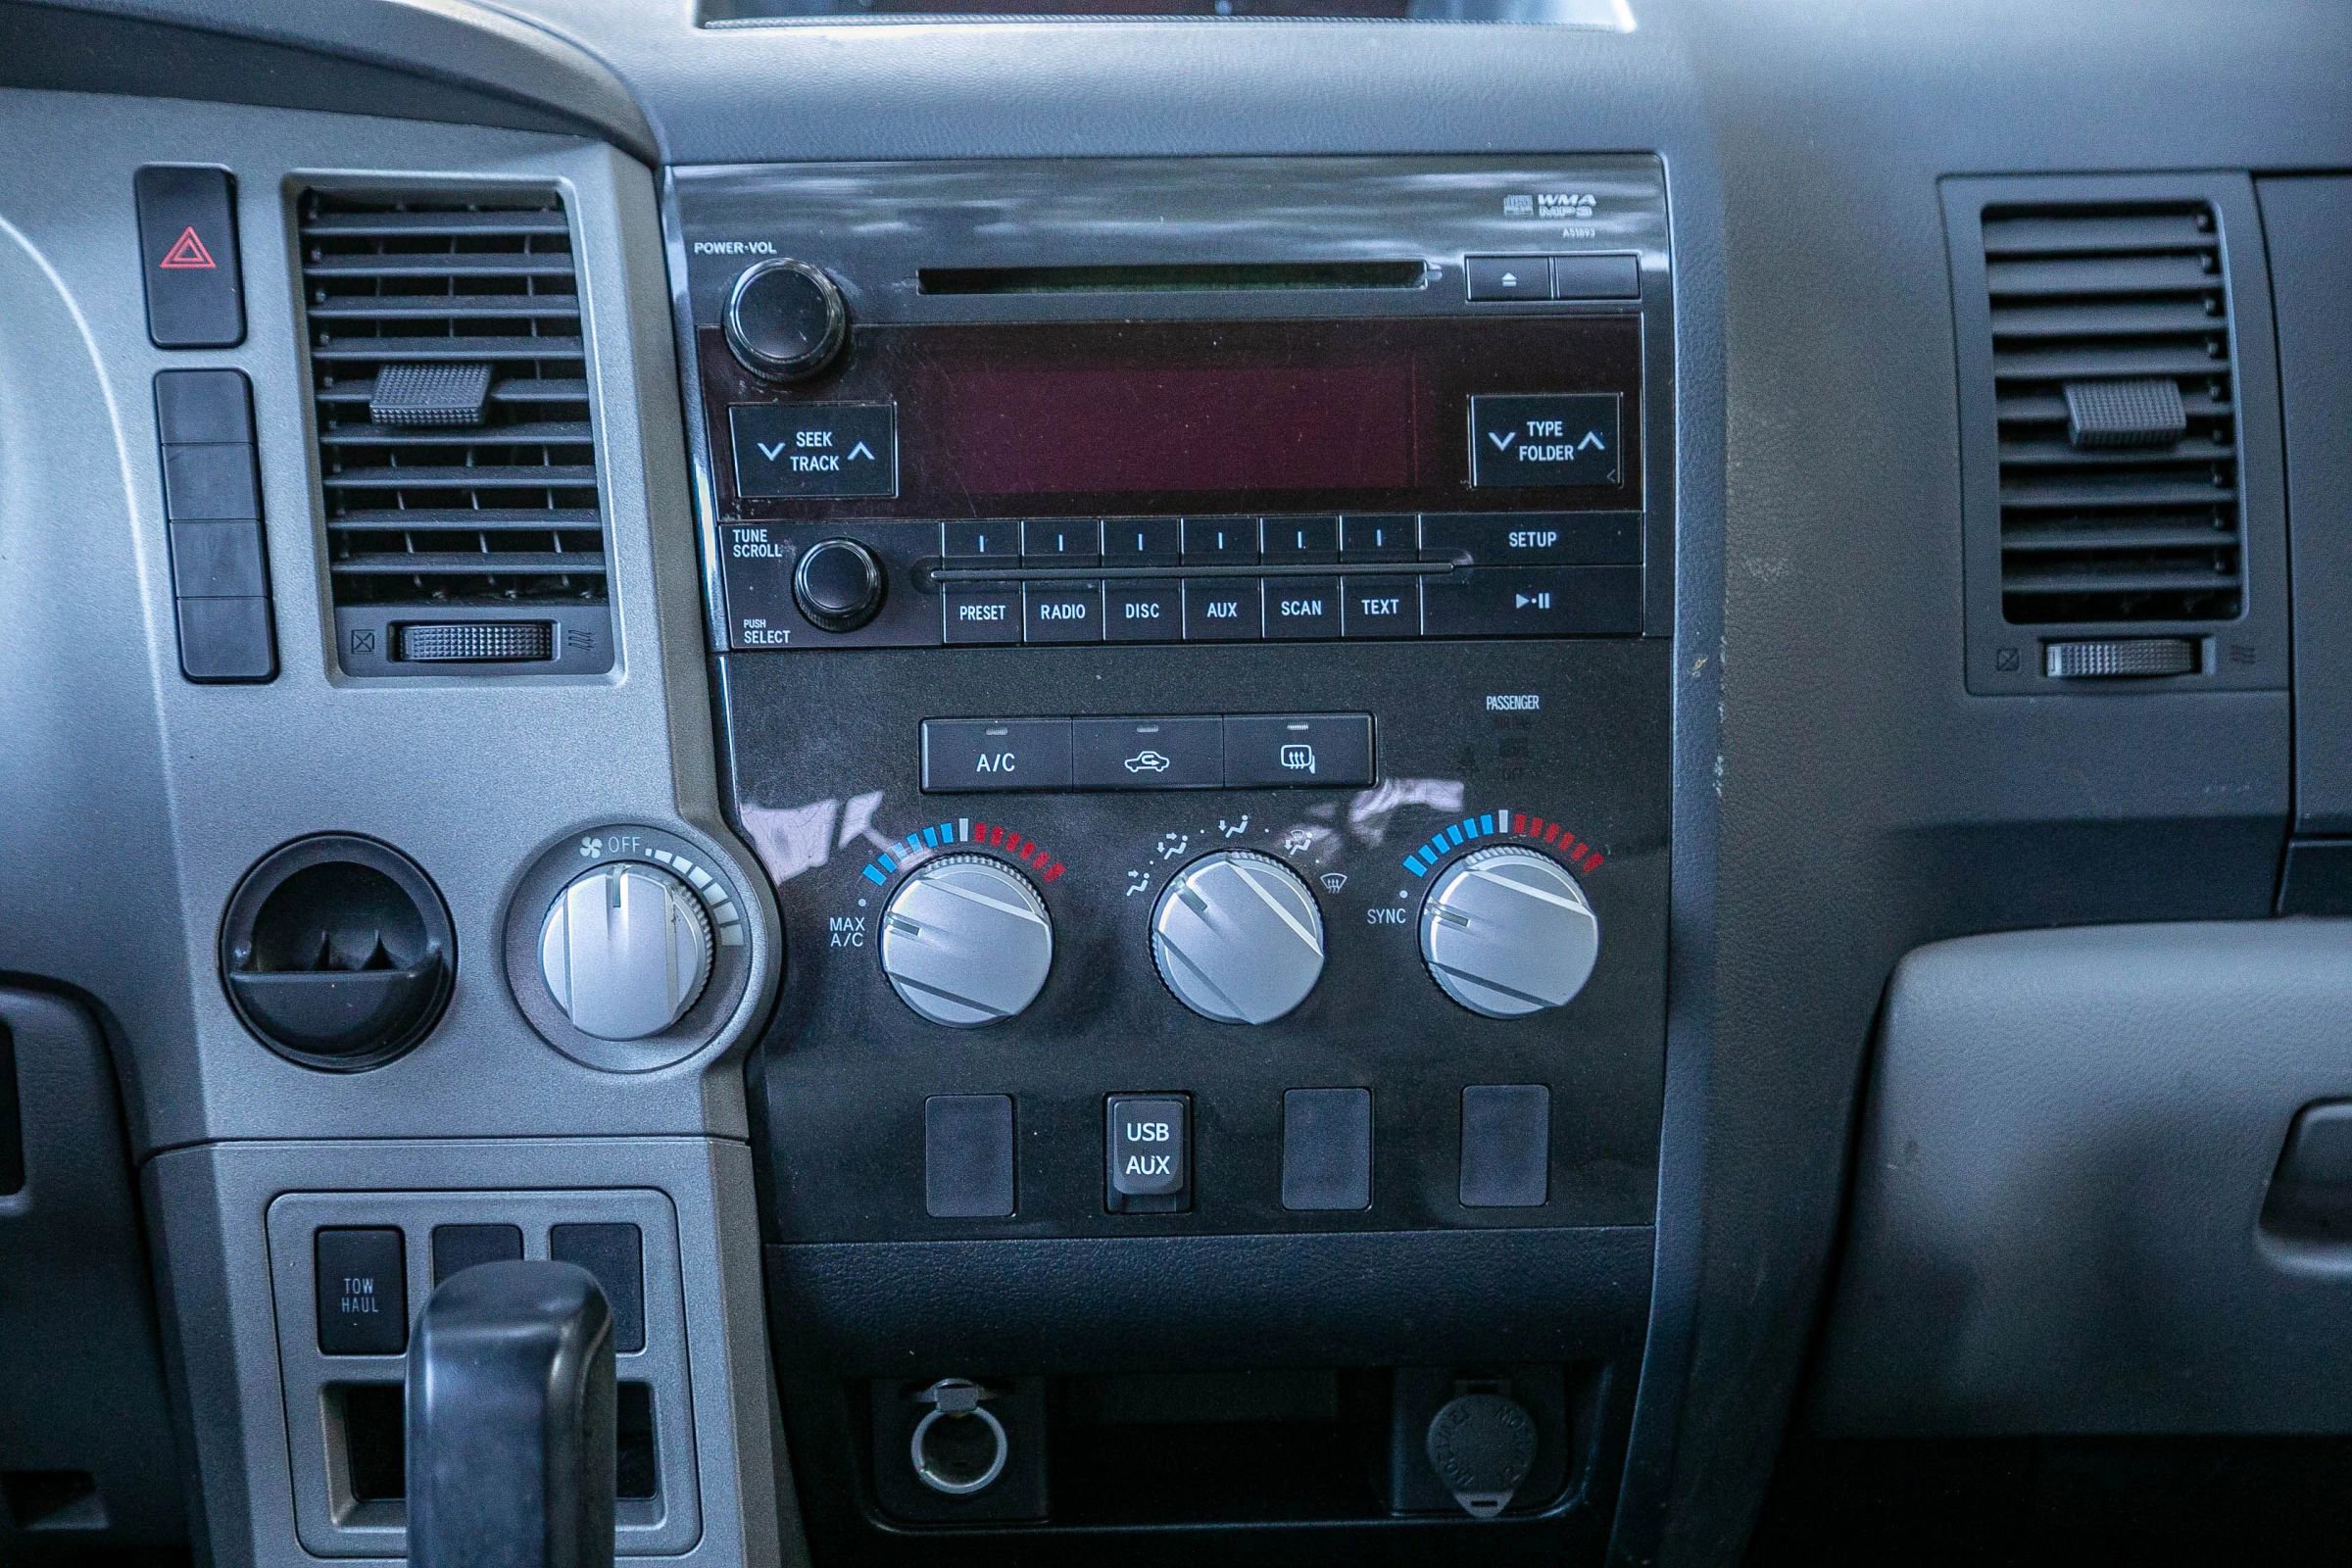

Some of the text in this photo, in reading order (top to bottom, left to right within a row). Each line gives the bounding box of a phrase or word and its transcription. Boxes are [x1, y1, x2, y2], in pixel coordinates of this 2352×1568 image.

[1538, 194, 1597, 206] WMA
[1526, 420, 1563, 437] TYPE
[796, 431, 833, 448] SEEK
[1519, 444, 1575, 462] FOLDER
[789, 455, 840, 471] TRACK
[733, 529, 768, 543] TUNE
[1508, 531, 1557, 548] SETUP
[733, 543, 783, 558] SCROLL
[959, 605, 1006, 621] PRESET
[1040, 604, 1086, 620] RADIO
[1125, 603, 1159, 619] DISC
[1206, 602, 1238, 618] AUX
[1281, 600, 1322, 616] SCAN
[1361, 599, 1399, 615] TEXT
[743, 618, 766, 629] PUSH
[744, 629, 791, 644] SELECT
[1486, 694, 1540, 710] PASSENGER
[976, 753, 1015, 772] A/C
[608, 836, 641, 854] OFF
[1367, 907, 1407, 924] SYNC
[829, 917, 865, 932] MAX
[830, 933, 863, 948] A/C
[1127, 1122, 1170, 1142] USB
[1125, 1154, 1171, 1175] AUX
[344, 1277, 373, 1295] TOW
[341, 1297, 379, 1313] HAUL
